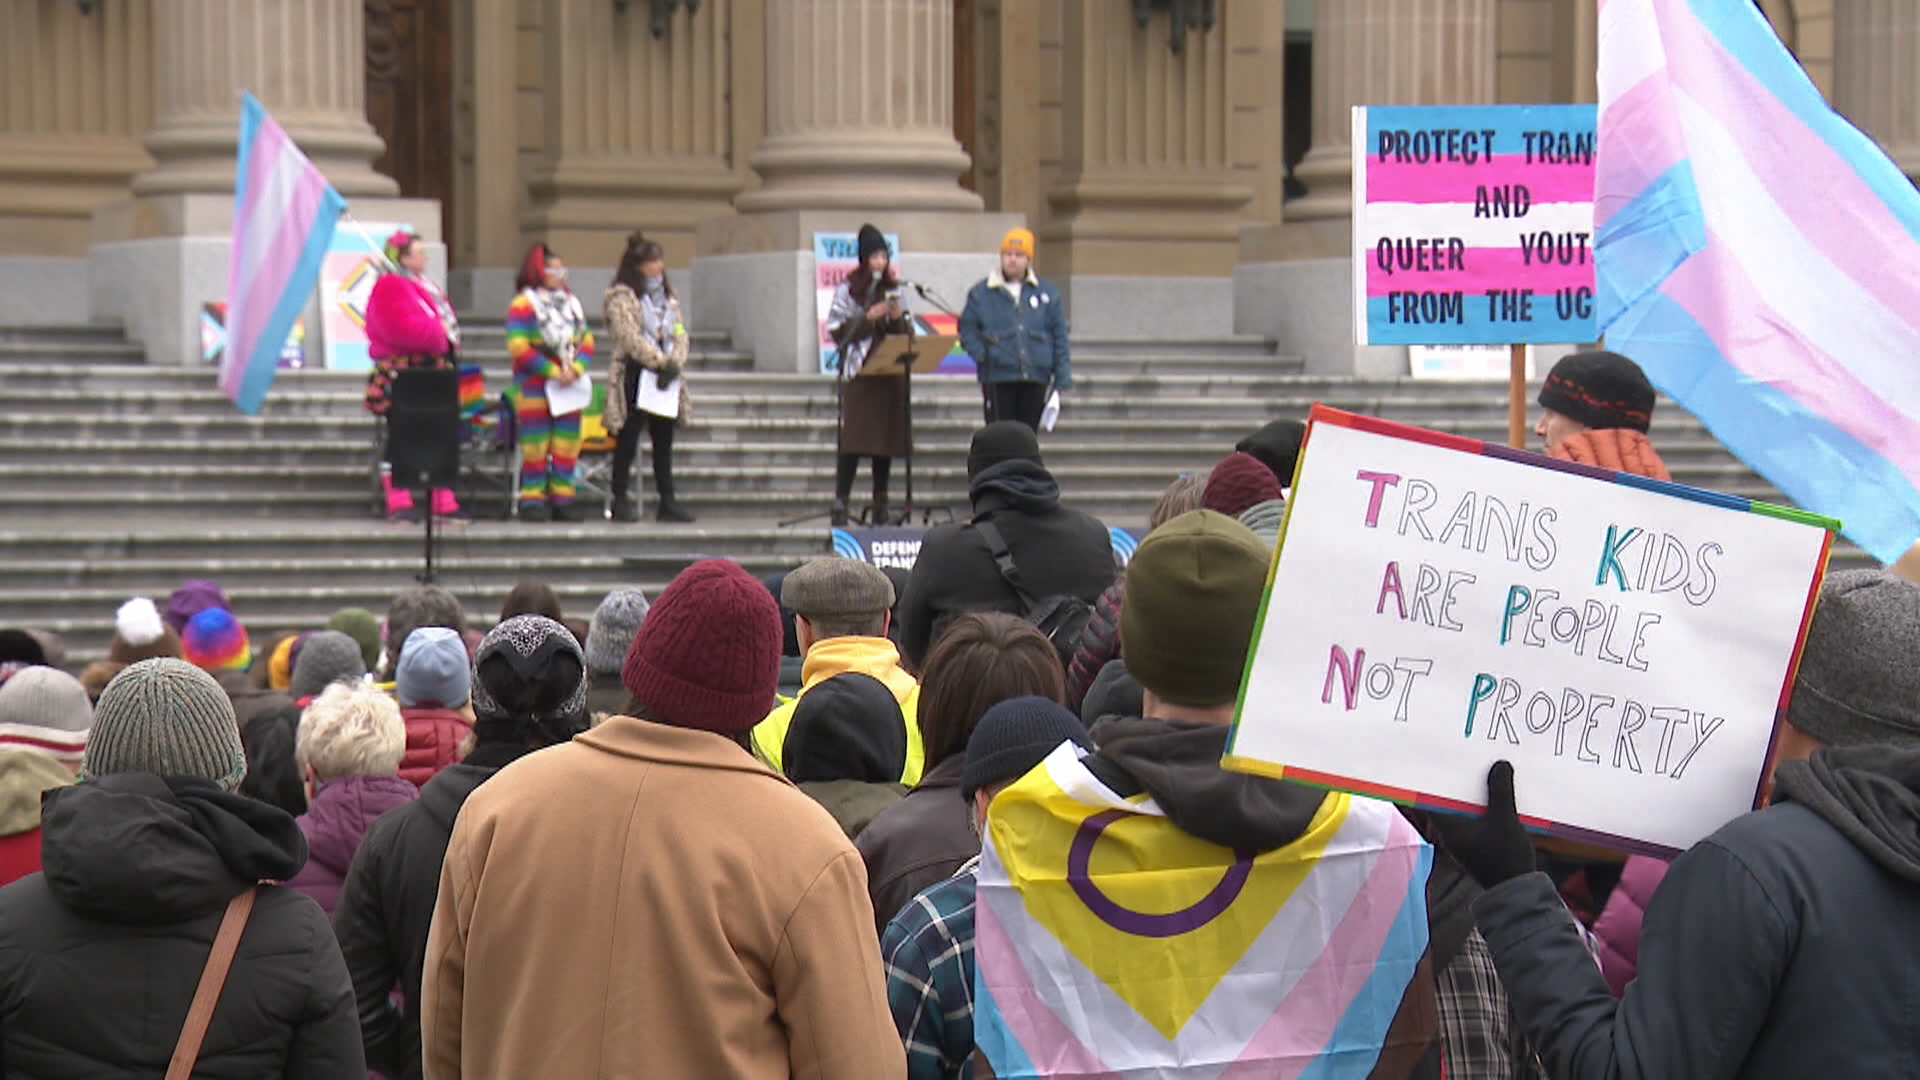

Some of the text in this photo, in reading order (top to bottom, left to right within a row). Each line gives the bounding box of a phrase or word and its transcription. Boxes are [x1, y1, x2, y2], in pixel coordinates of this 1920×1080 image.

[1379, 129, 1597, 166] PROTECT TRAN
[1474, 184, 1531, 219] AND
[1376, 230, 1594, 276] QUEER YOUT
[1388, 290, 1464, 325] FROM
[1486, 289, 1533, 322] THE
[1356, 469, 1723, 606] TRANS KIDS
[872, 556, 917, 570] TRAN
[1376, 561, 1661, 672] ARE PEOPLE
[1321, 643, 1725, 779] NOT PROPERTY
